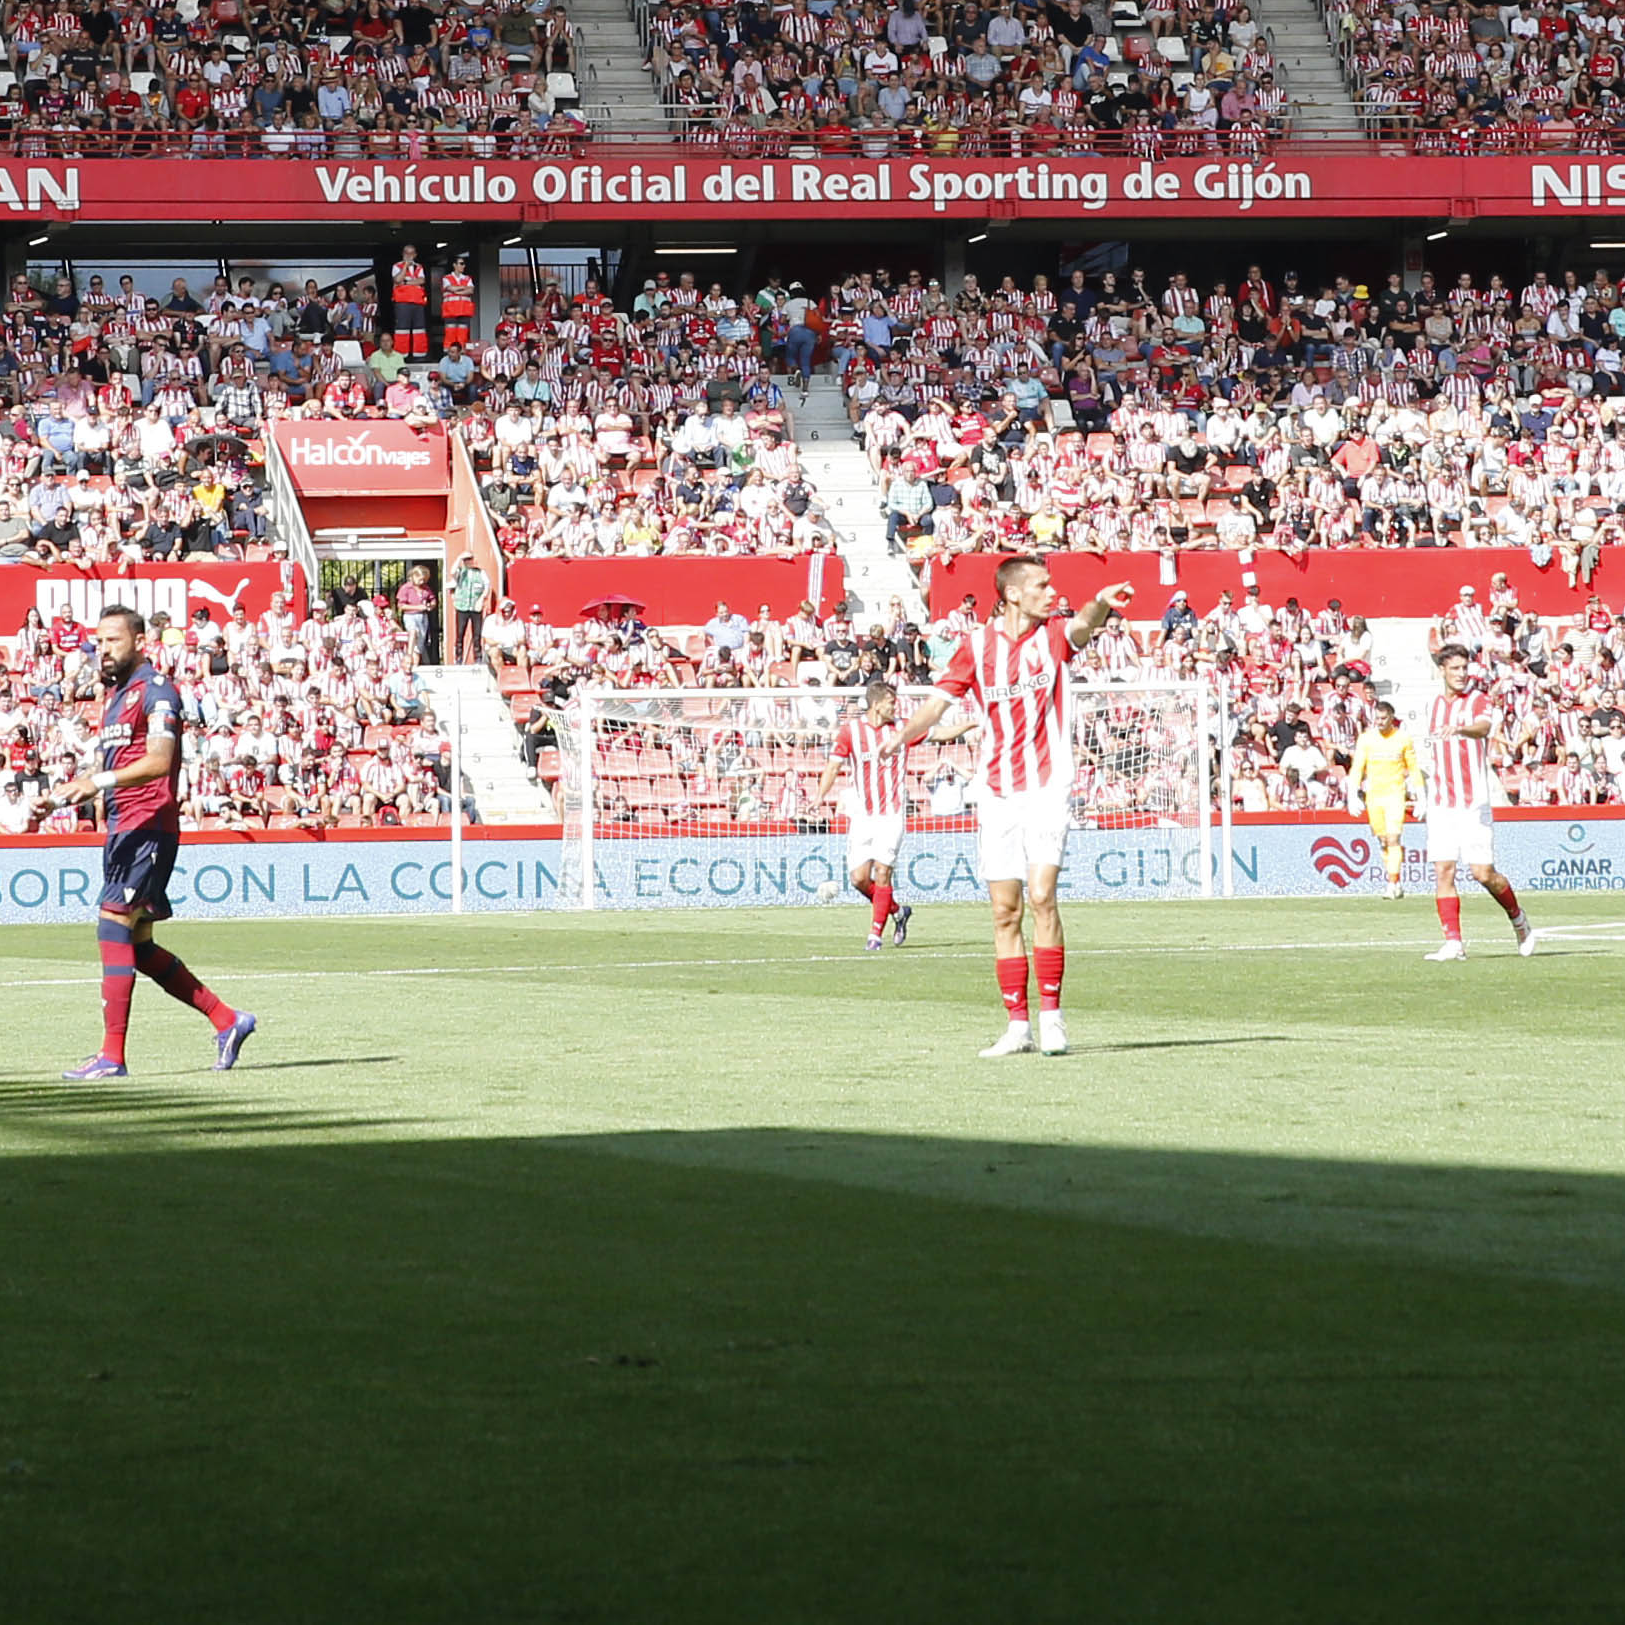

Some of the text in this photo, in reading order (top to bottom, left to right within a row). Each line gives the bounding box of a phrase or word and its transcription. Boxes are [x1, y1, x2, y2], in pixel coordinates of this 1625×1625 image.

[316, 162, 1310, 211] Vehículo Oficial del Real Sporting de Gijón
[291, 430, 381, 466] Halcón
[36, 578, 187, 628] PUMA
[308, 864, 369, 901] LA
[635, 841, 976, 898] ECONÓCA
[1541, 858, 1612, 876] GANAR
